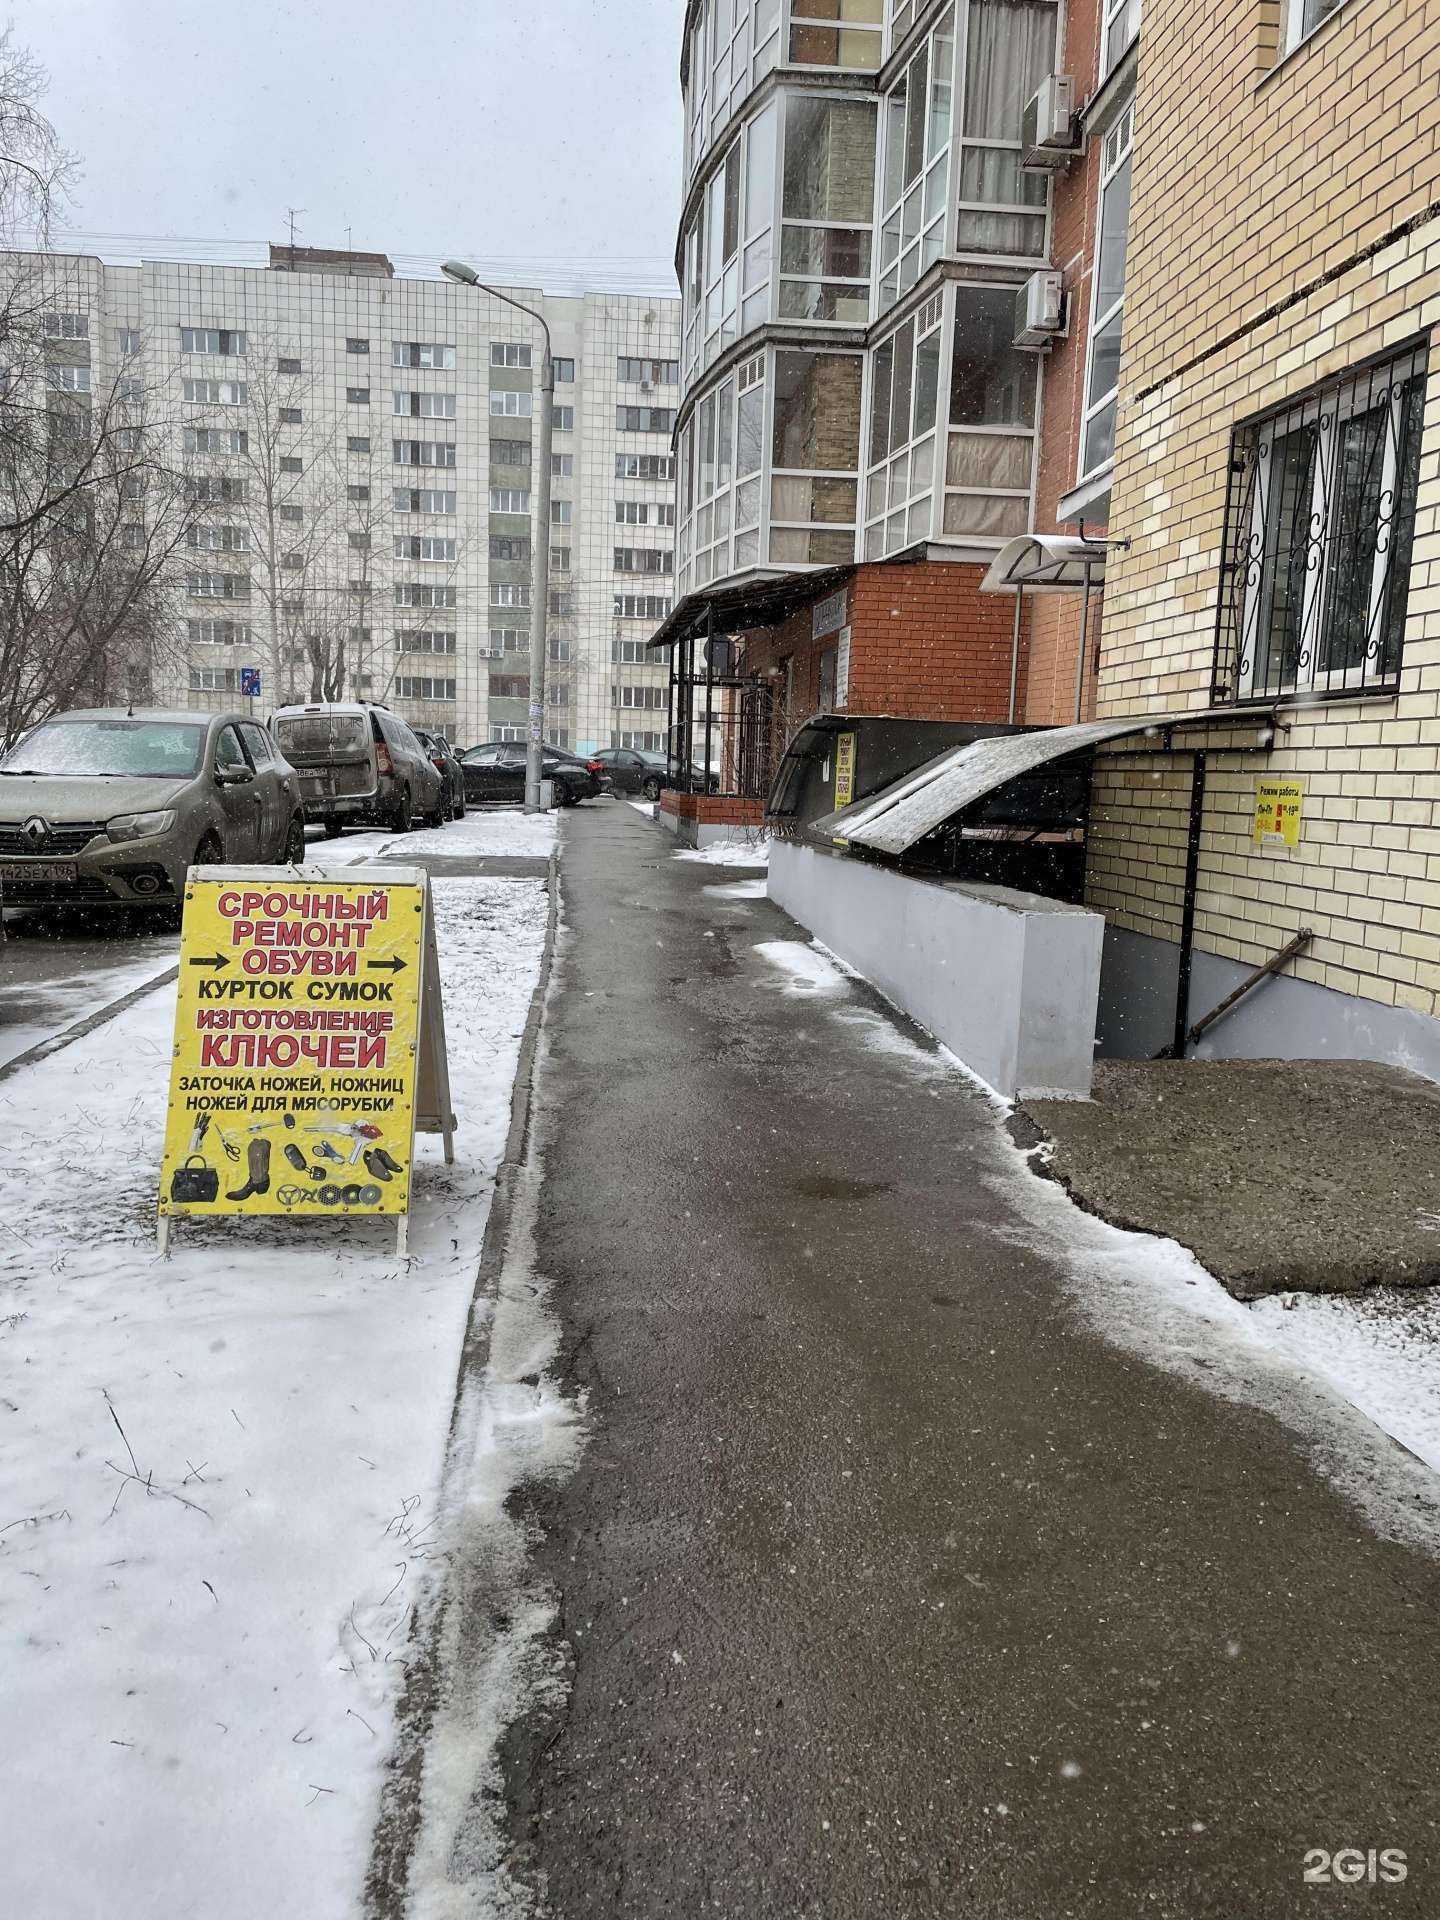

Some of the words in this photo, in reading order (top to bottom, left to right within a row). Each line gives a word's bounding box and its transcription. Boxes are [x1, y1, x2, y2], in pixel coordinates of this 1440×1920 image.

[217, 890, 389, 920] СРОЧНЫЙ
[232, 920, 373, 948] РЕМОНТ
[241, 949, 357, 976] ОБУВИ
[198, 980, 294, 1000] КУРТОК
[306, 981, 394, 1001] СУМОК
[196, 1009, 394, 1031] ИЗГОТОВЛЕНИЕ
[201, 1030, 387, 1069] КЛЮЧЕЙ
[178, 1077, 256, 1091] ЗАТОЧКА
[260, 1075, 325, 1093] НОЖЕЙ,
[330, 1077, 404, 1094] НОЖНИЦ
[186, 1094, 248, 1111] НОЖЕЙ
[251, 1096, 288, 1113] ДЛЯ
[291, 1096, 394, 1112] МЯСОРУБКИ
